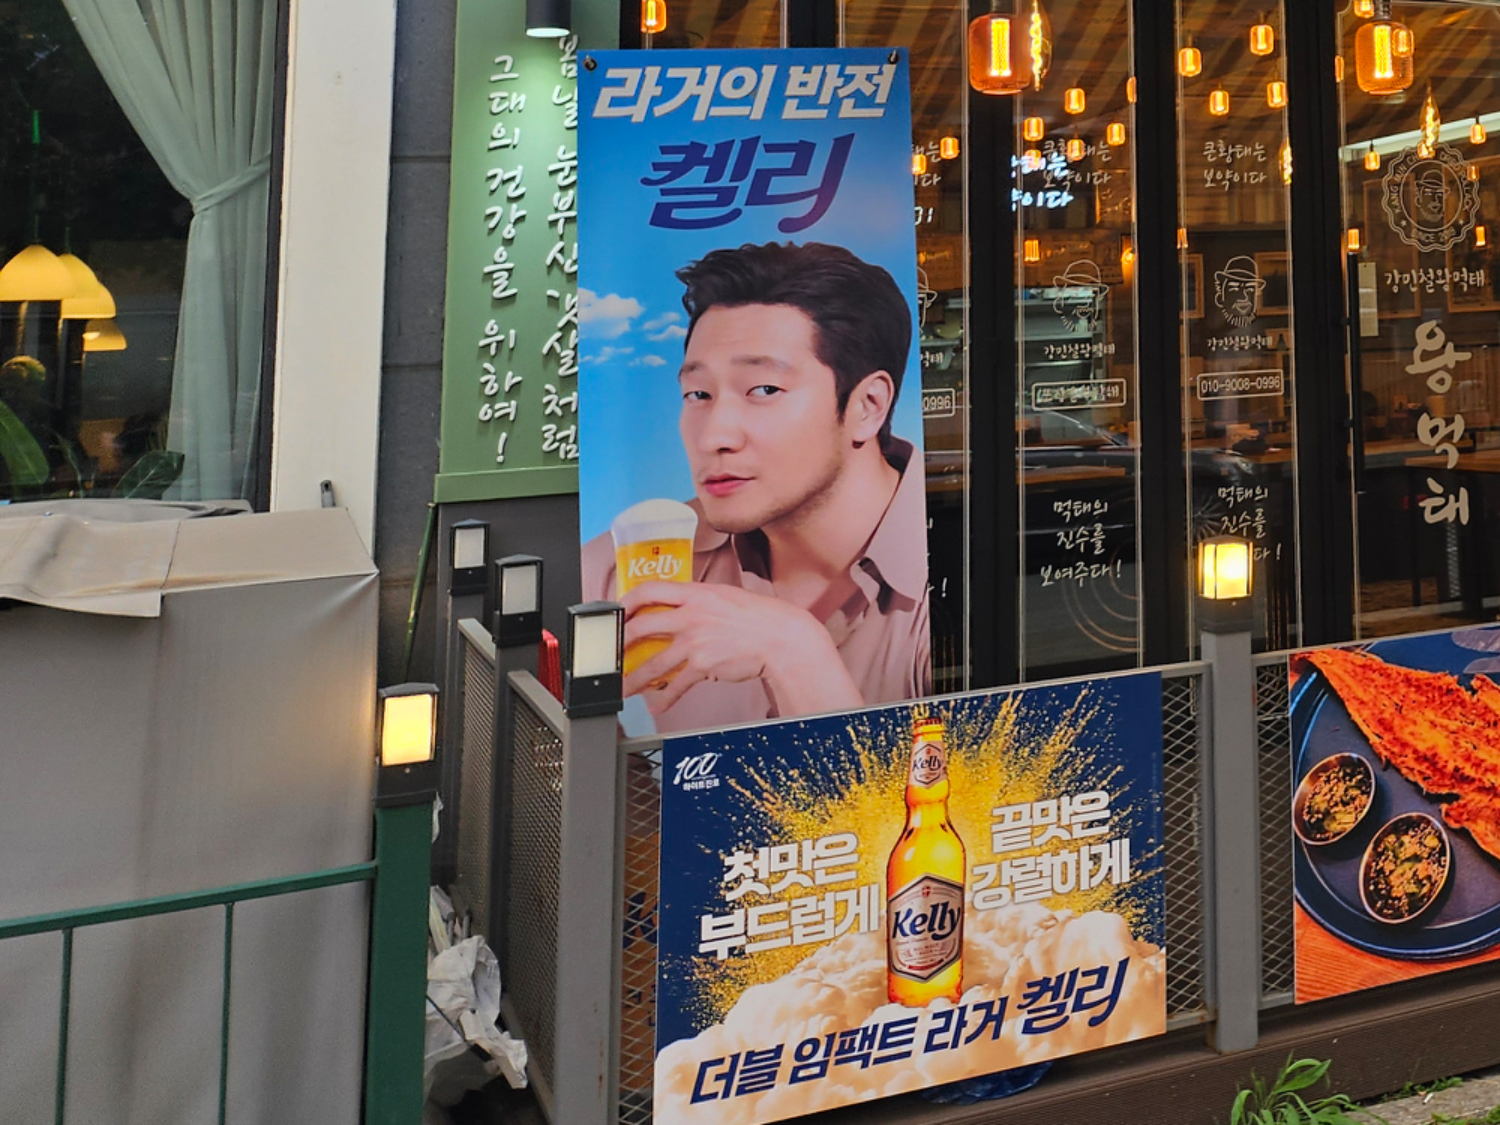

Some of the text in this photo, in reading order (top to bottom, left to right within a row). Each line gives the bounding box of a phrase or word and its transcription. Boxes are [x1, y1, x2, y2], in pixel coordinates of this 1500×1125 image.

[488, 54, 526, 151] 그대의
[592, 62, 899, 123] 라거의 반전
[640, 132, 856, 234] 켈리
[1203, 170, 1267, 191] 보약이다
[483, 165, 527, 300] 건강을
[1384, 267, 1485, 294] 강민철왕먹태
[1200, 375, 1280, 394] 010-9008-0996
[1404, 319, 1473, 526] 왕먹태
[1053, 497, 1108, 523] 먹태의
[1218, 485, 1268, 508] 먹태의
[1056, 523, 1106, 555] 진수를
[1220, 508, 1267, 539] 진수를
[628, 554, 684, 578] Kelly
[912, 755, 942, 771] Kelly
[991, 790, 1111, 852] 끝맛은
[723, 832, 859, 901] 첫맛은
[972, 838, 1131, 911] 강렬하게
[699, 884, 880, 960] 부드럽게
[892, 900, 961, 941] Kelly
[689, 958, 1129, 1104] 더블 임팩트 라거 켈리
